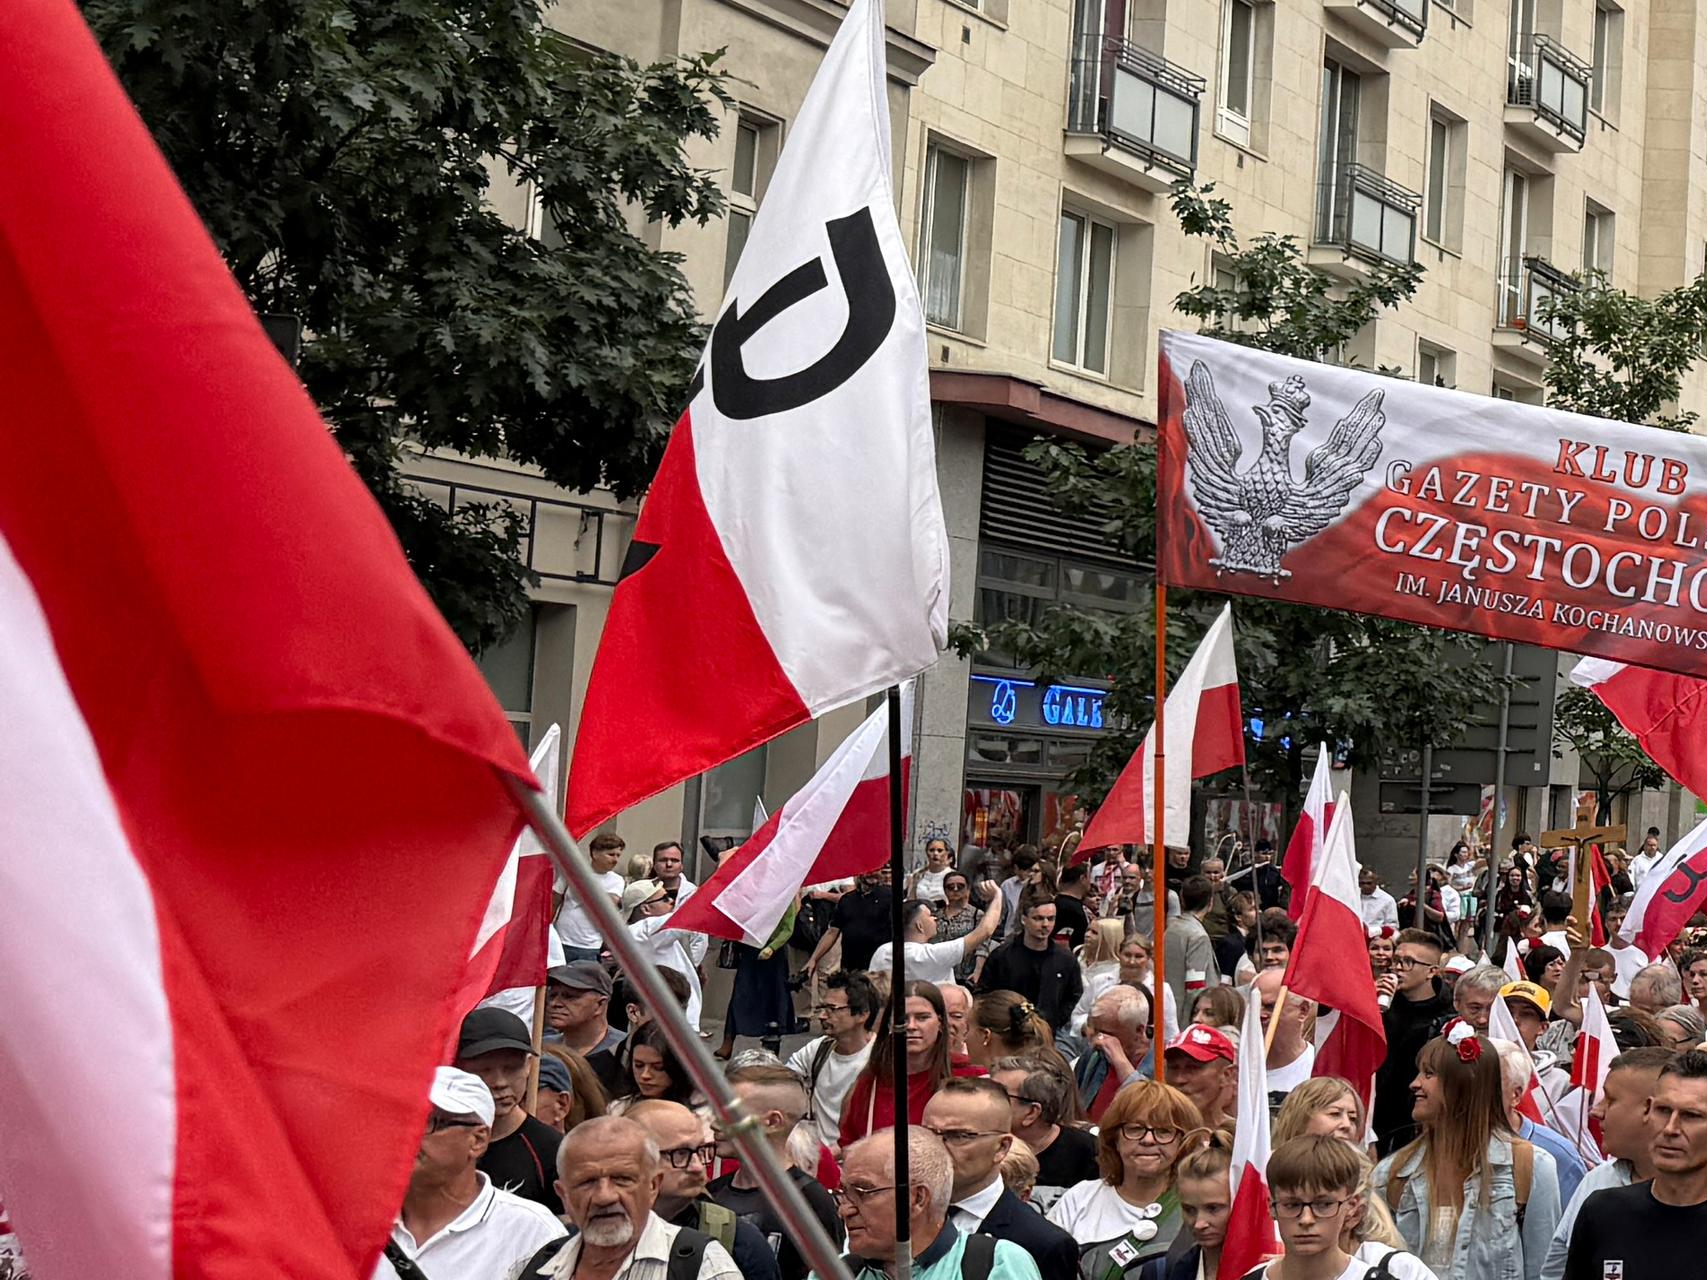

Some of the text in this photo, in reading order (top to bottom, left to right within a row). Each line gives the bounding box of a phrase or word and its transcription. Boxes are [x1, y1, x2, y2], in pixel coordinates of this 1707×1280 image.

[1385, 459, 1585, 524] GAZETY
[1553, 439, 1690, 496] KLUB
[1394, 571, 1432, 600] IM.
[1436, 577, 1545, 622] JANUSZA
